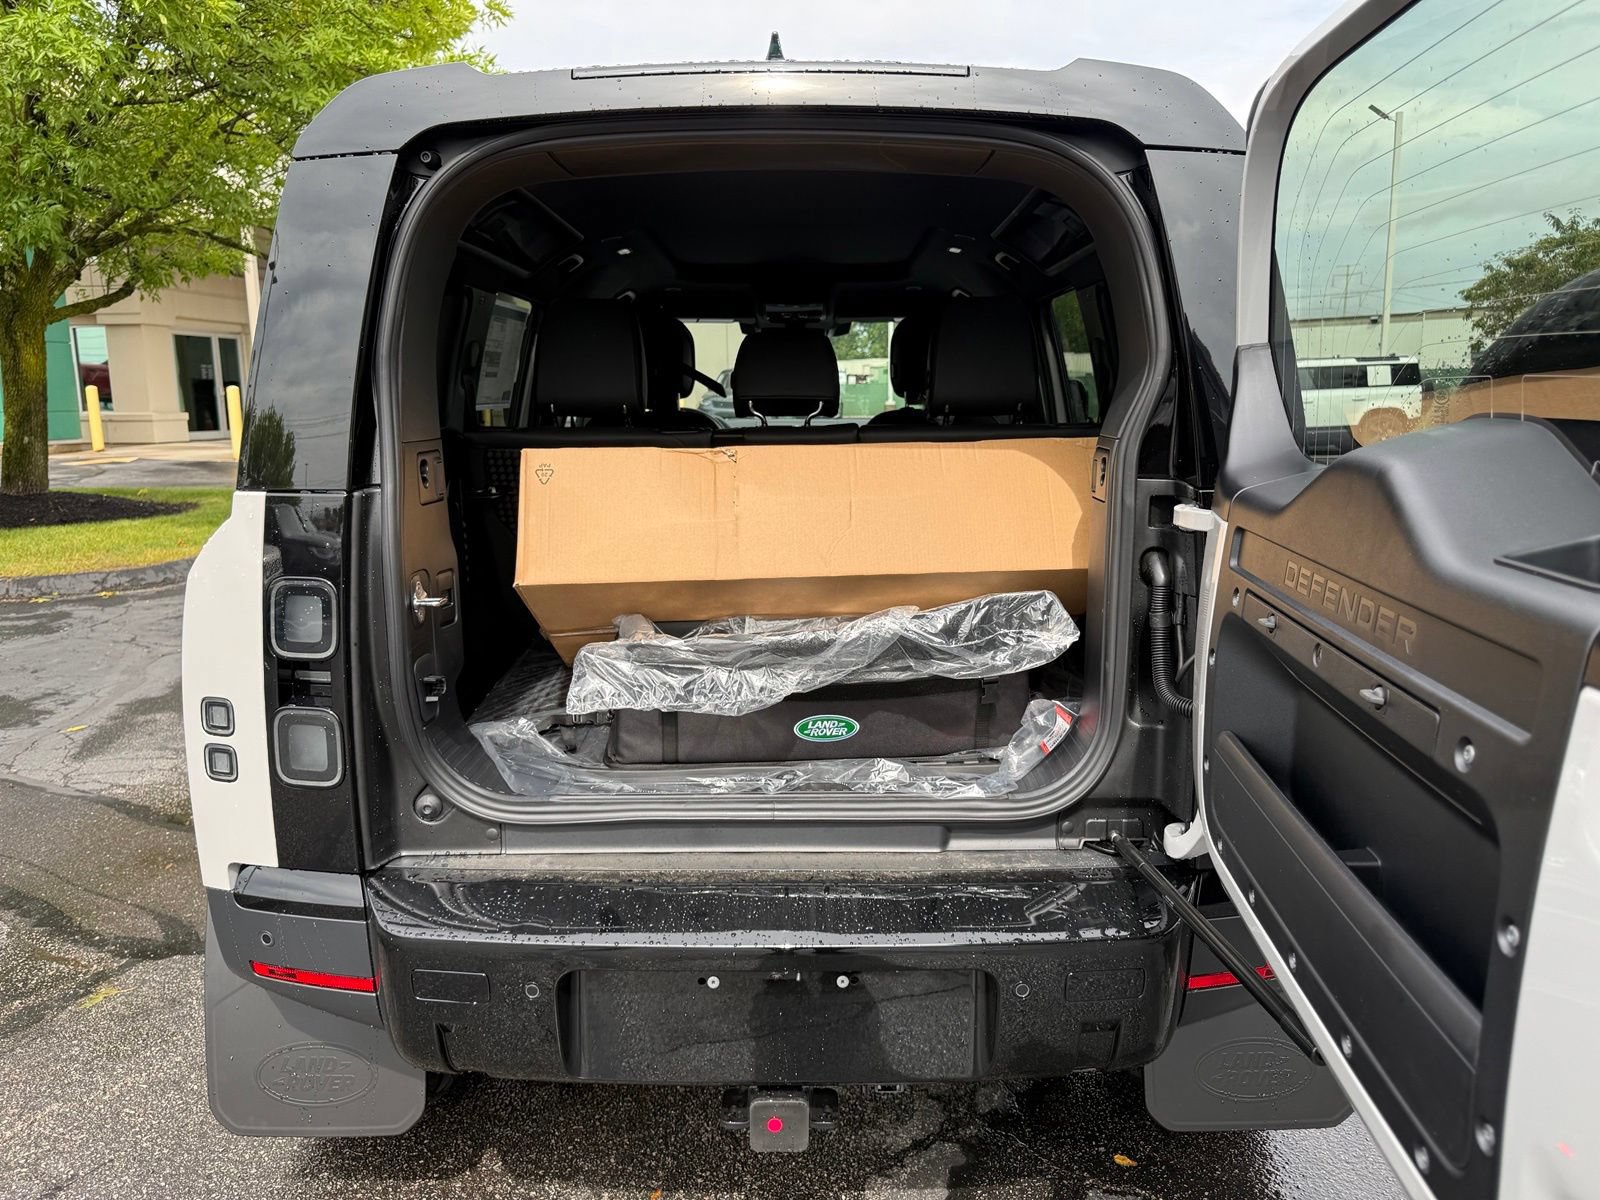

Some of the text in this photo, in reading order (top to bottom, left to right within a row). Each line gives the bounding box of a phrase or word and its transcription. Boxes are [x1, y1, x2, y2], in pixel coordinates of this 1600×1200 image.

[1284, 560, 1417, 655] DEFENDER
[807, 720, 838, 729] LAND
[810, 728, 848, 737] ROVER
[280, 1055, 338, 1073] LAND
[284, 1074, 356, 1092] ROVER
